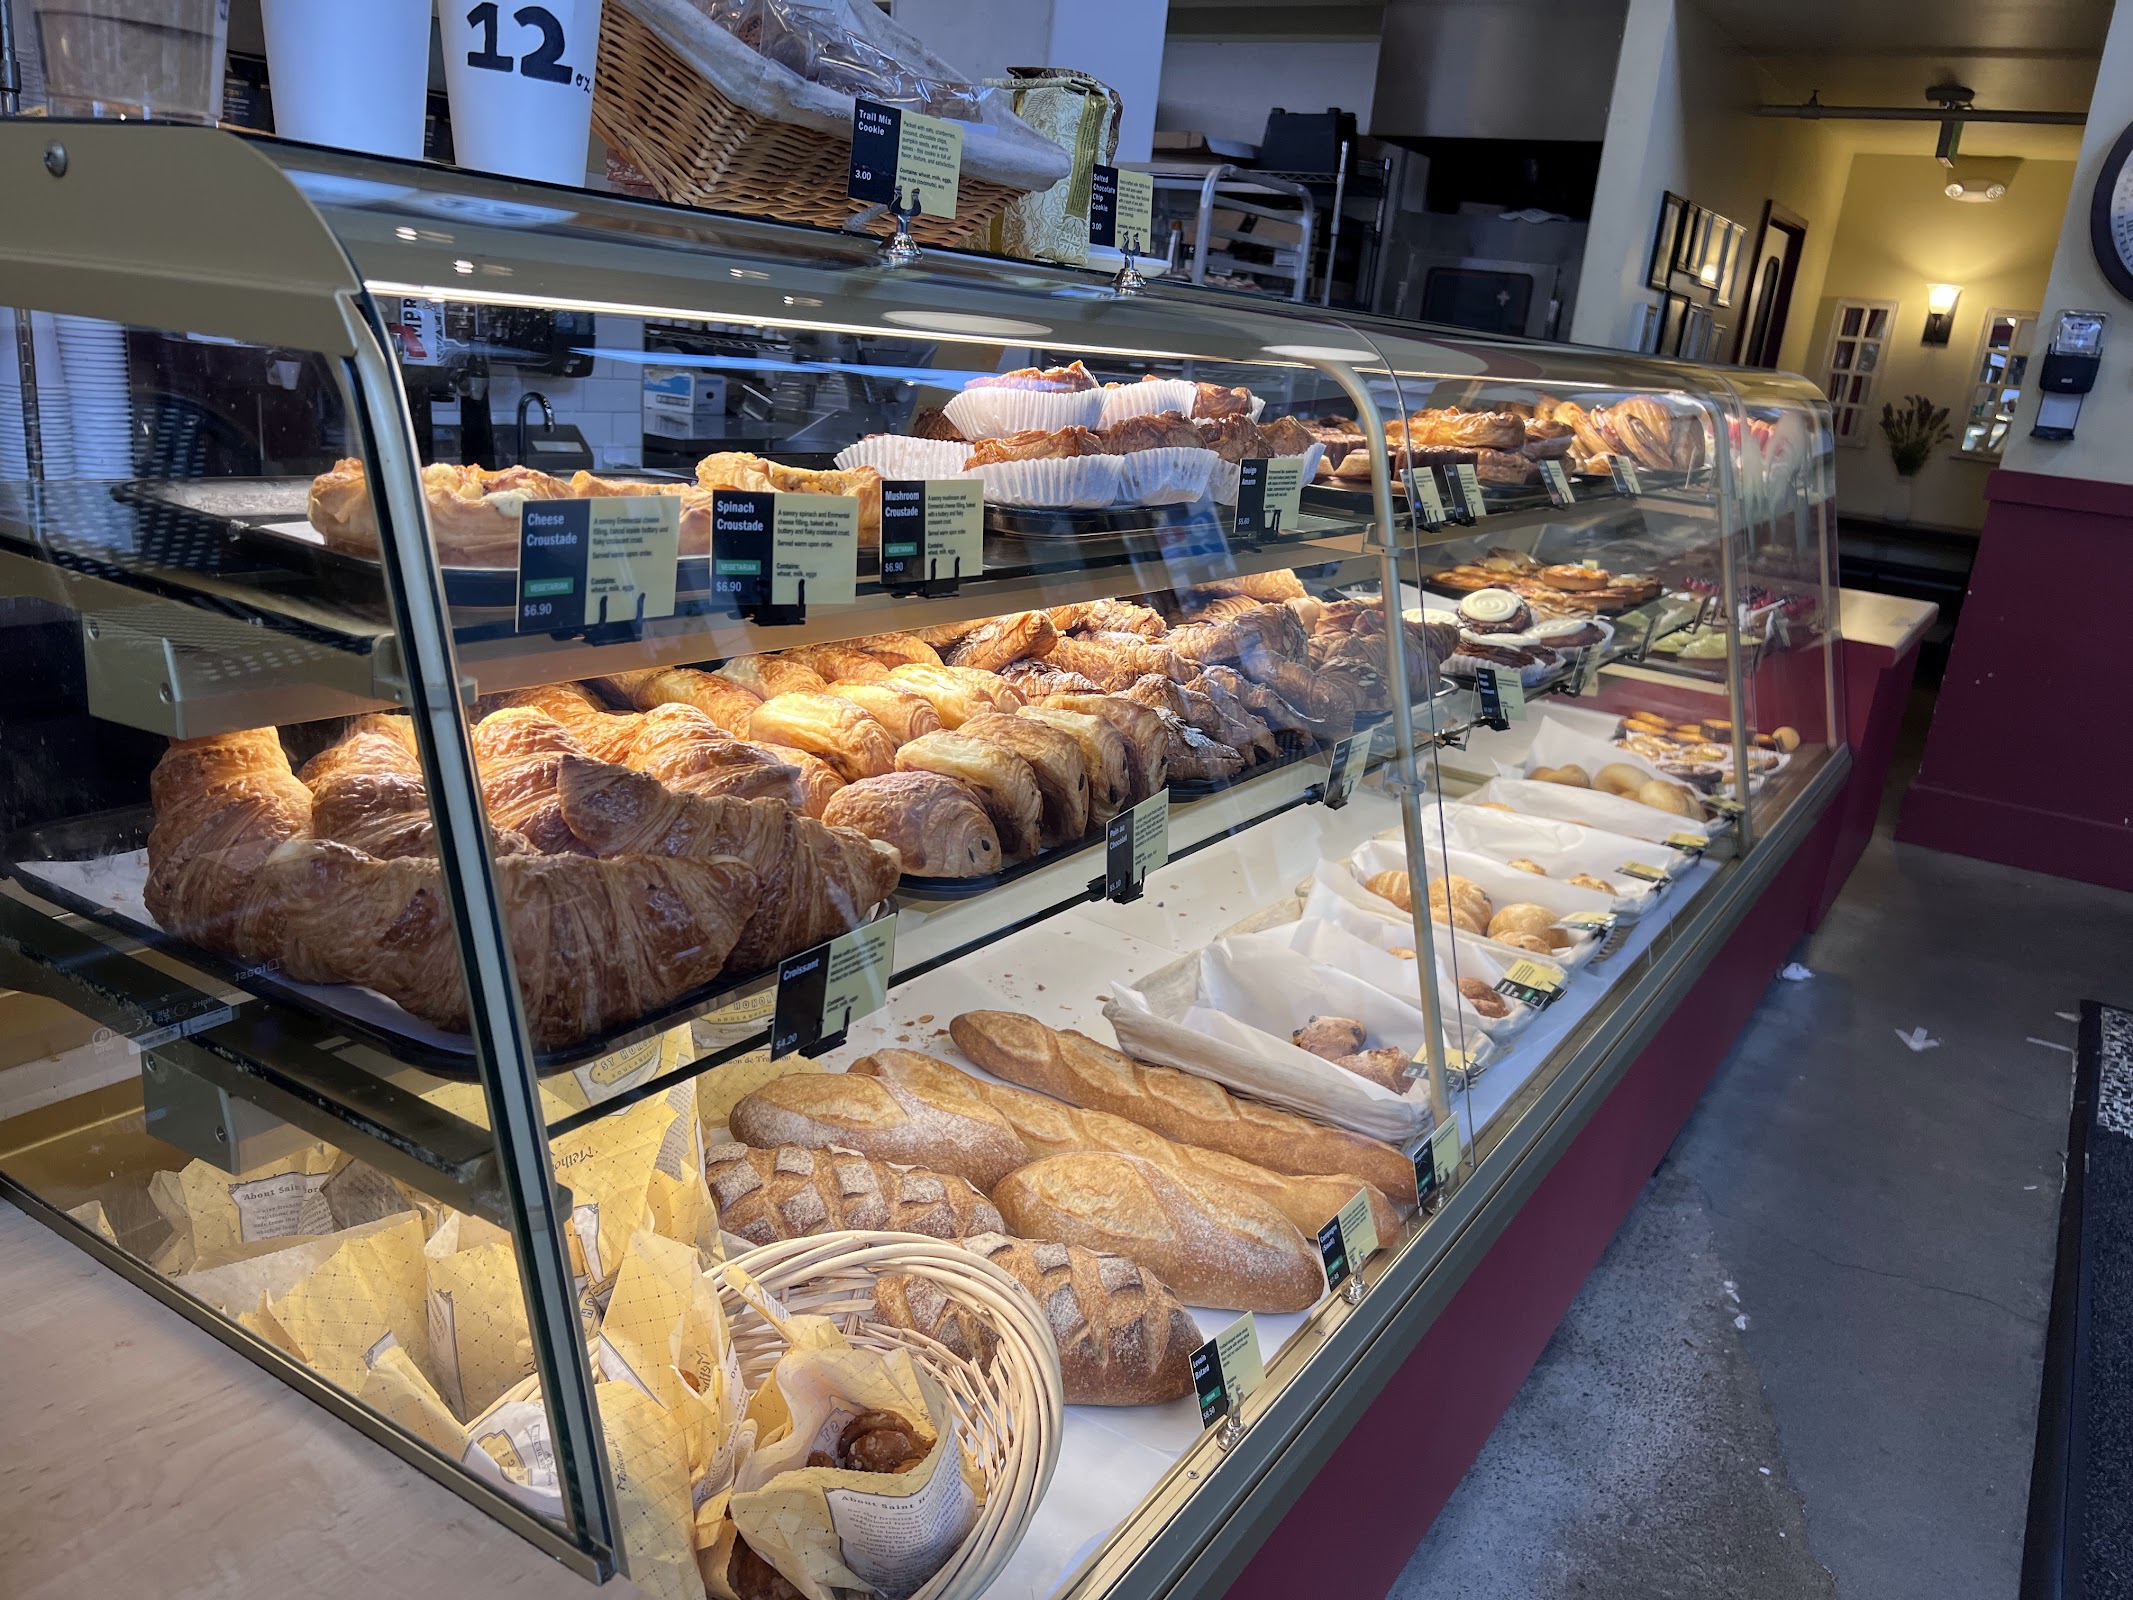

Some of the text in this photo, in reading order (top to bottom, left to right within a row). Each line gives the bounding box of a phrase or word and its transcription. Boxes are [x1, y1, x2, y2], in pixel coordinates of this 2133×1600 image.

[466, 2, 573, 84] 12
[859, 109, 891, 125] Trail Mix
[859, 122, 884, 135] Cookie
[855, 170, 871, 180] 3.00
[1094, 174, 1108, 183] Salted
[1093, 184, 1115, 194] Chocolate
[1093, 193, 1103, 202] Chip
[1092, 203, 1108, 211] Cookie
[1092, 222, 1102, 230] 3.00
[885, 491, 919, 501] Mushroom
[717, 500, 754, 514] Spinach
[885, 506, 918, 517] Croustade
[528, 513, 564, 526] Cheese
[717, 518, 763, 532] Croustade
[527, 532, 577, 547] Croustade
[885, 562, 903, 572] $6.90
[716, 581, 741, 592] $6.90
[524, 603, 552, 617] $6.90
[783, 958, 819, 981] Croissant
[734, 992, 775, 1010] HONOR
[776, 1033, 797, 1050] $4.20
[601, 1057, 614, 1070] ST
[244, 1184, 301, 1200] About Sain
[842, 1496, 877, 1506] About
